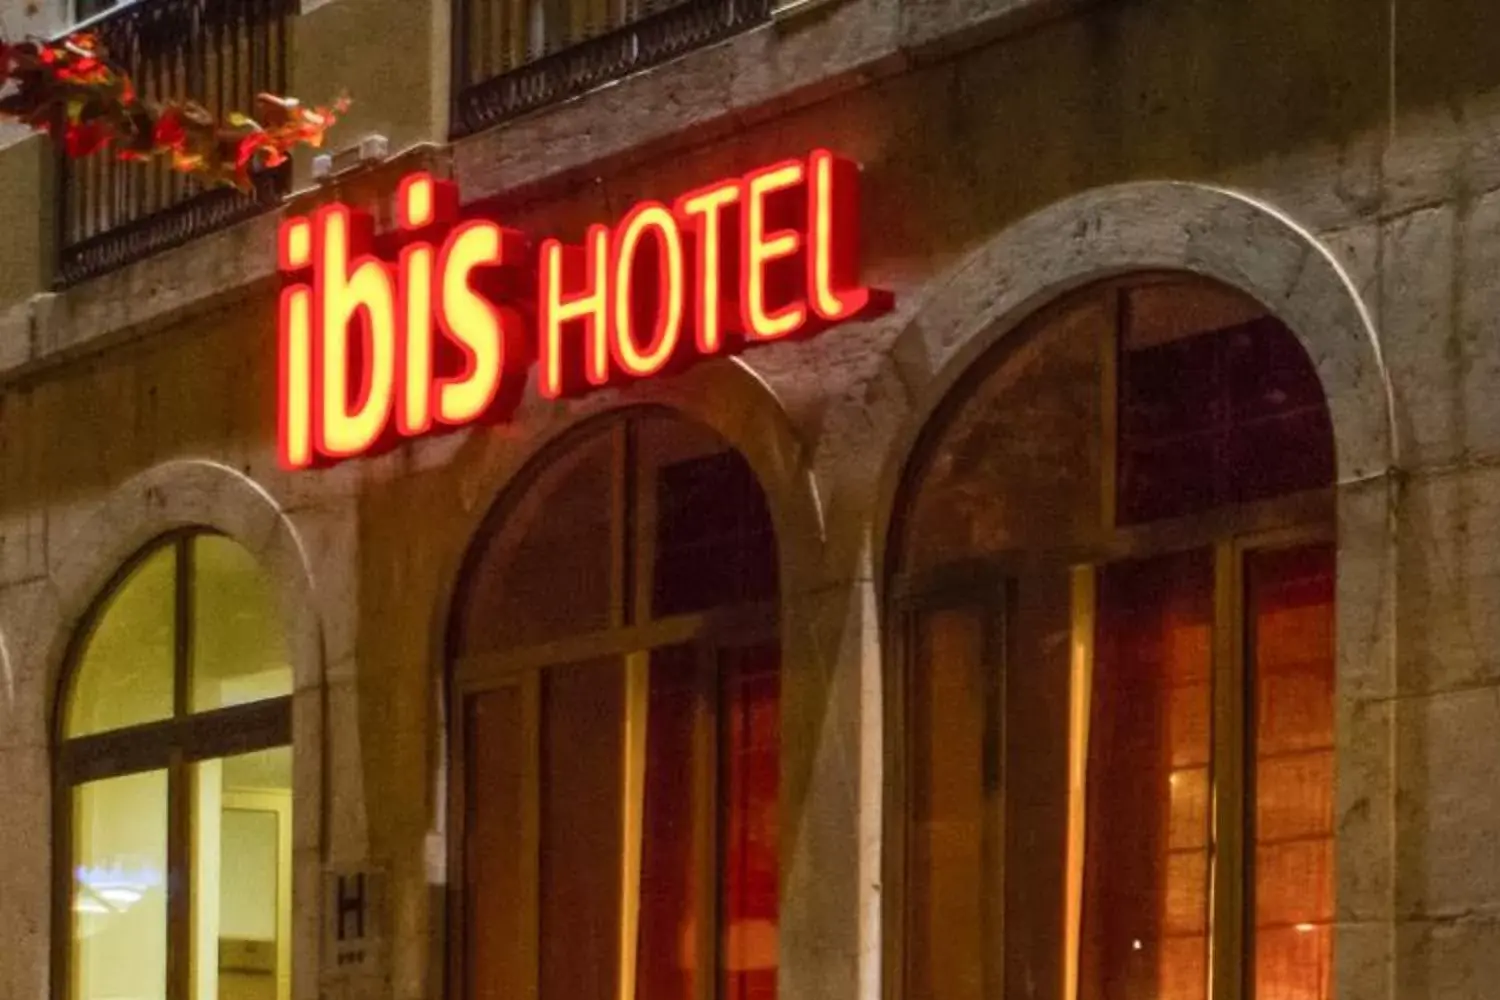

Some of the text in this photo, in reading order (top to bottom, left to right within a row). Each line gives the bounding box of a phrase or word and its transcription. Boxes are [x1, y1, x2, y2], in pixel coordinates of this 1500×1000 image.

[279, 149, 868, 472] ibis HOTEL
[337, 872, 365, 941] H
